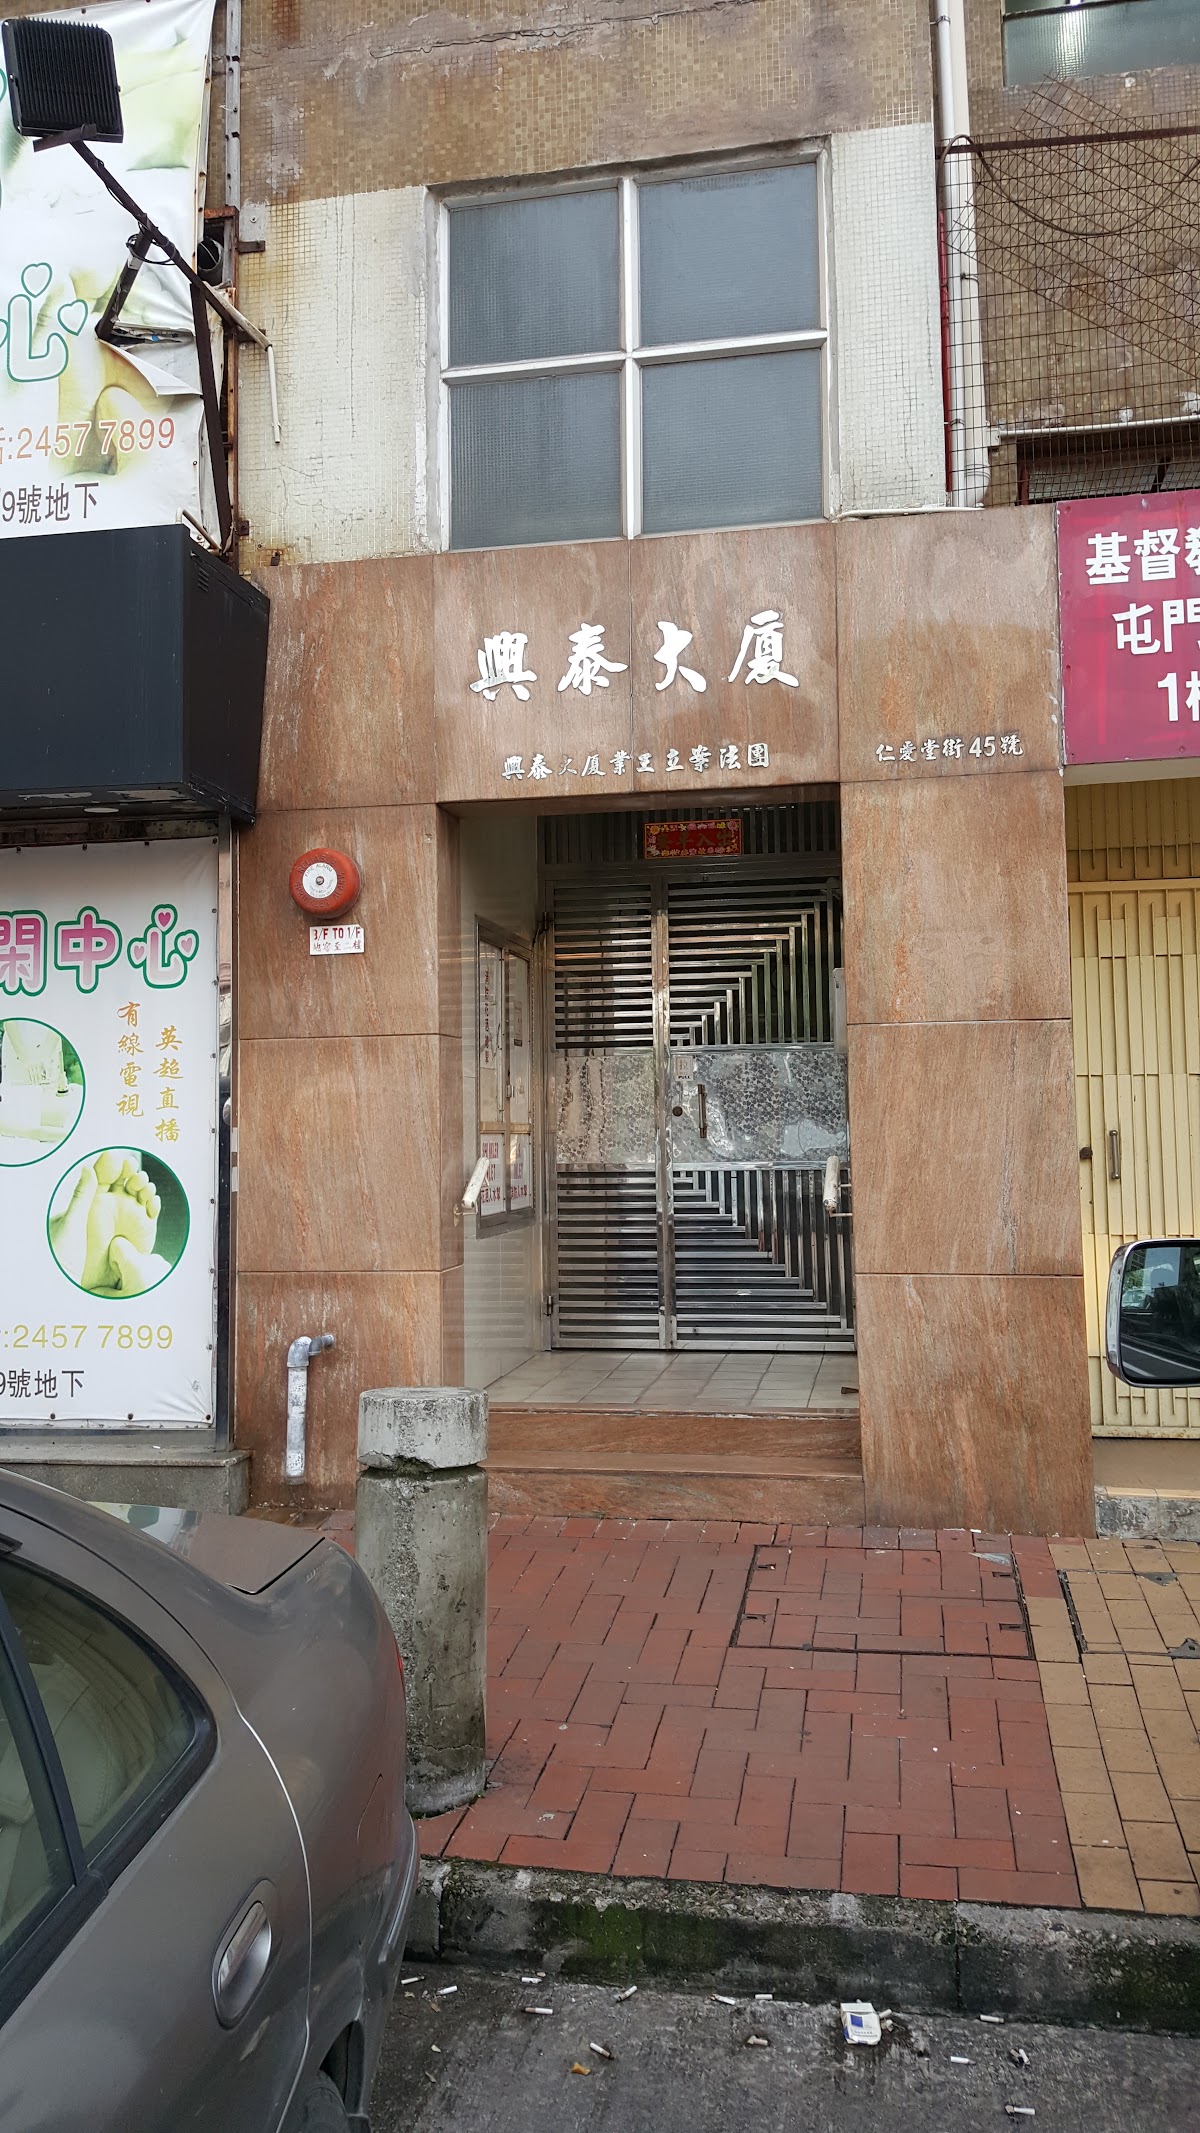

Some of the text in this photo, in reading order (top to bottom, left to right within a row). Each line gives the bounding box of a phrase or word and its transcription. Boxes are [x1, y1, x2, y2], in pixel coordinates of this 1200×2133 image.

[0, 417, 175, 464] :2457 7899
[1112, 597, 1200, 655] 屯門
[332, 927, 344, 939] TO
[116, 1001, 144, 1118] 有線電視
[153, 1025, 184, 1143] 英超直播
[97, 1324, 173, 1349] 7899
